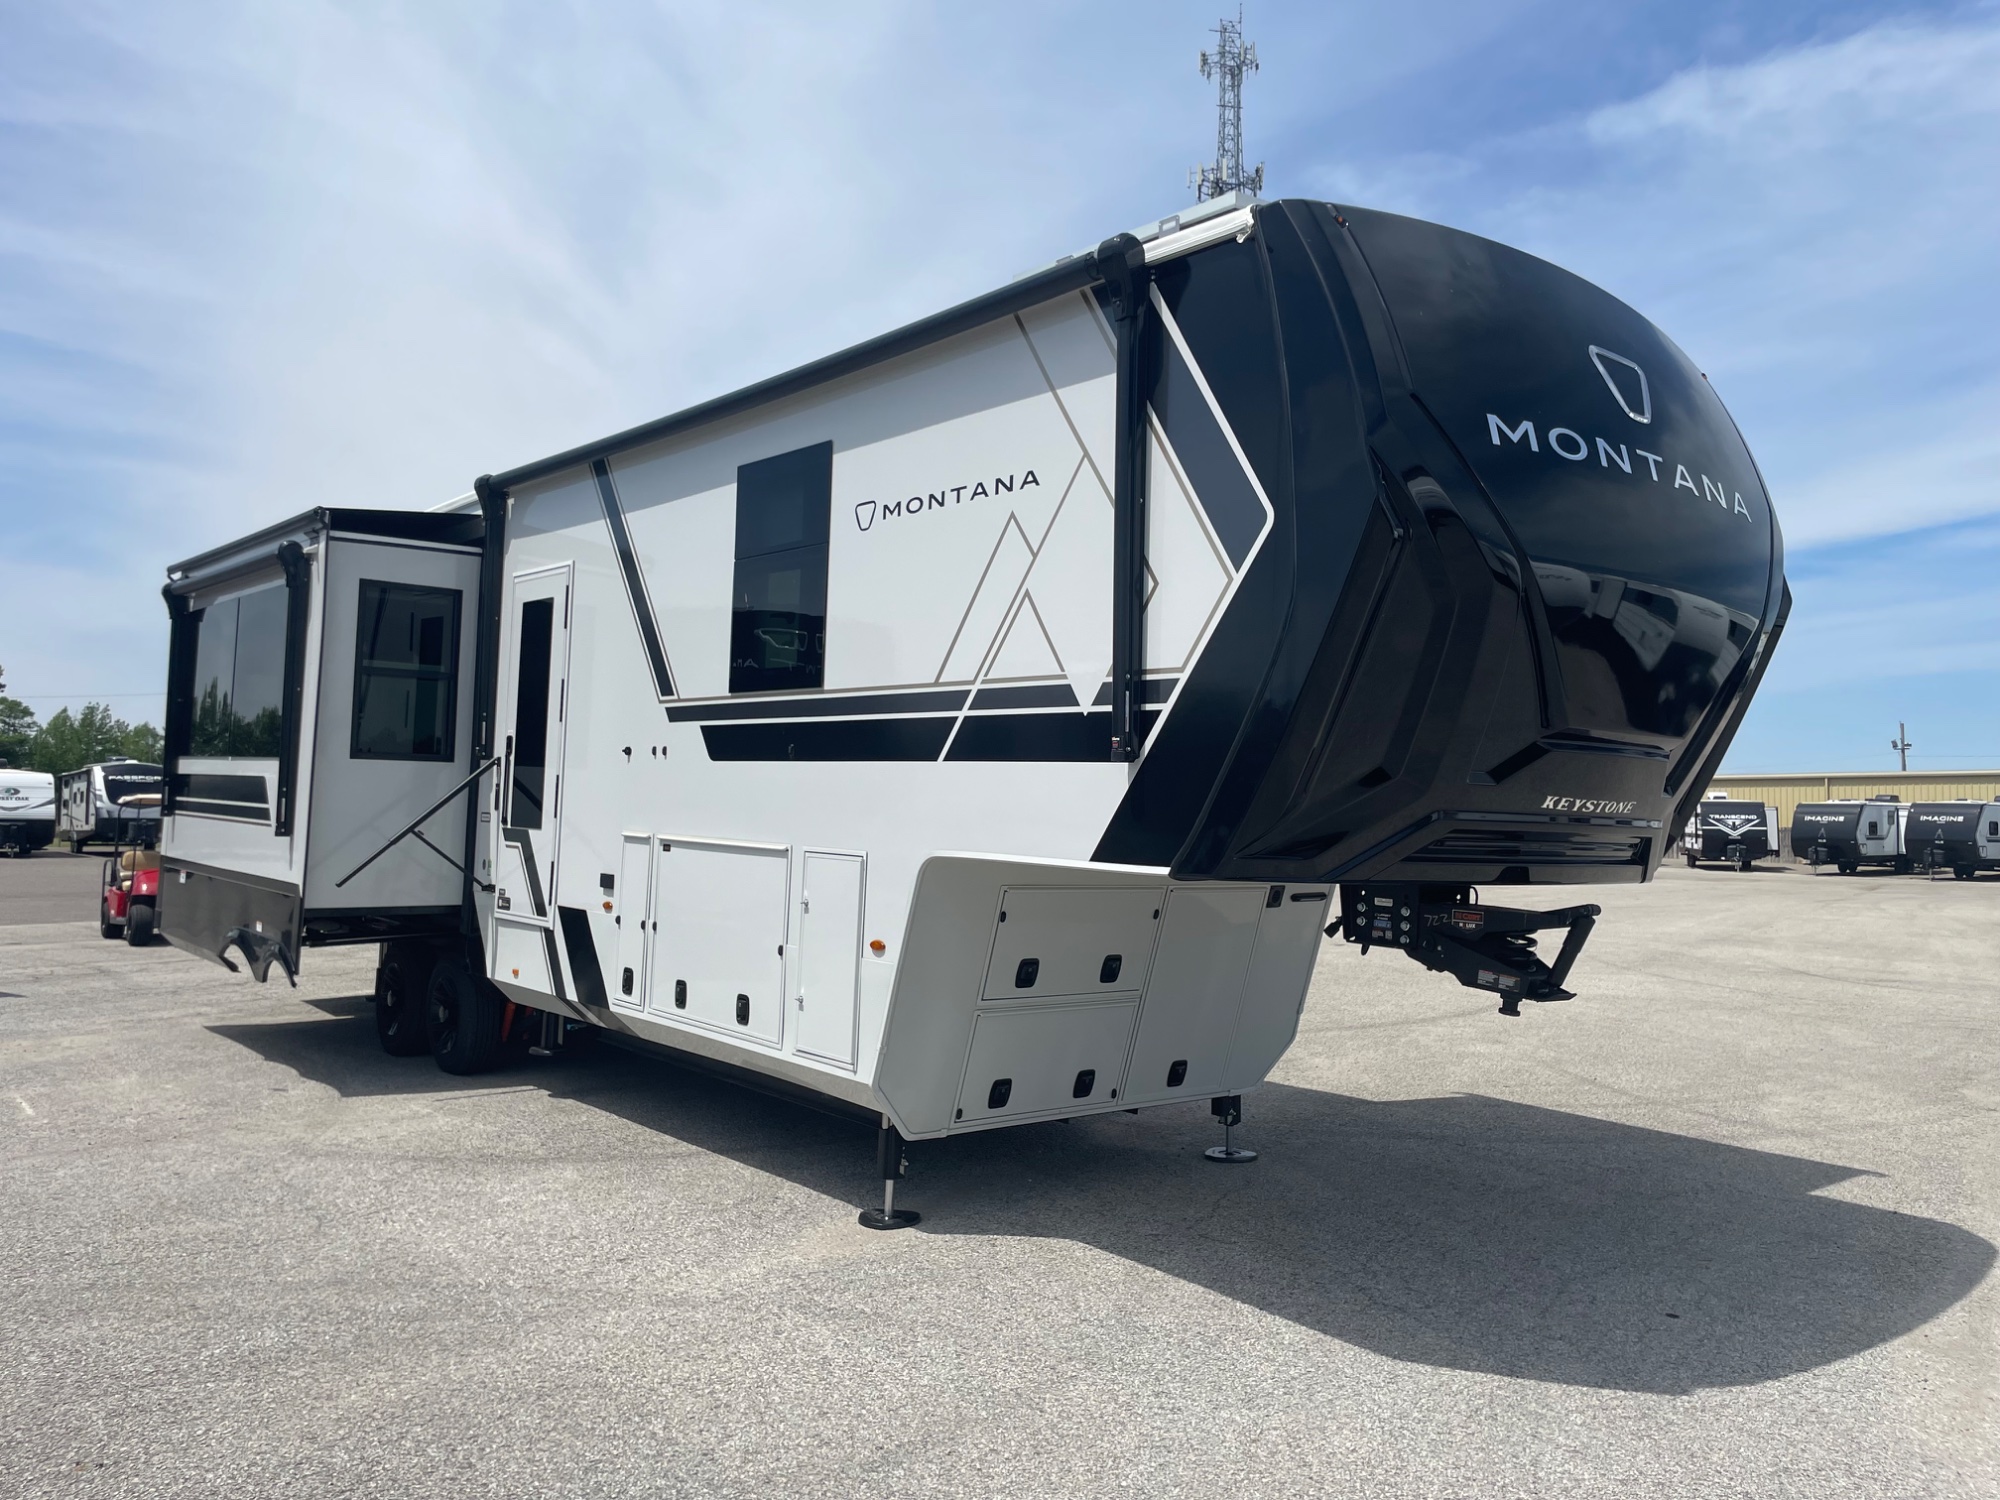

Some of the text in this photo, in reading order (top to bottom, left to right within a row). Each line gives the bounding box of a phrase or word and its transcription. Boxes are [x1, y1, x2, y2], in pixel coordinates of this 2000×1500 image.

[1486, 413, 1752, 523] MONTANA
[882, 470, 1040, 520] MONTANA
[1541, 795, 1637, 814] KEYSTONE
